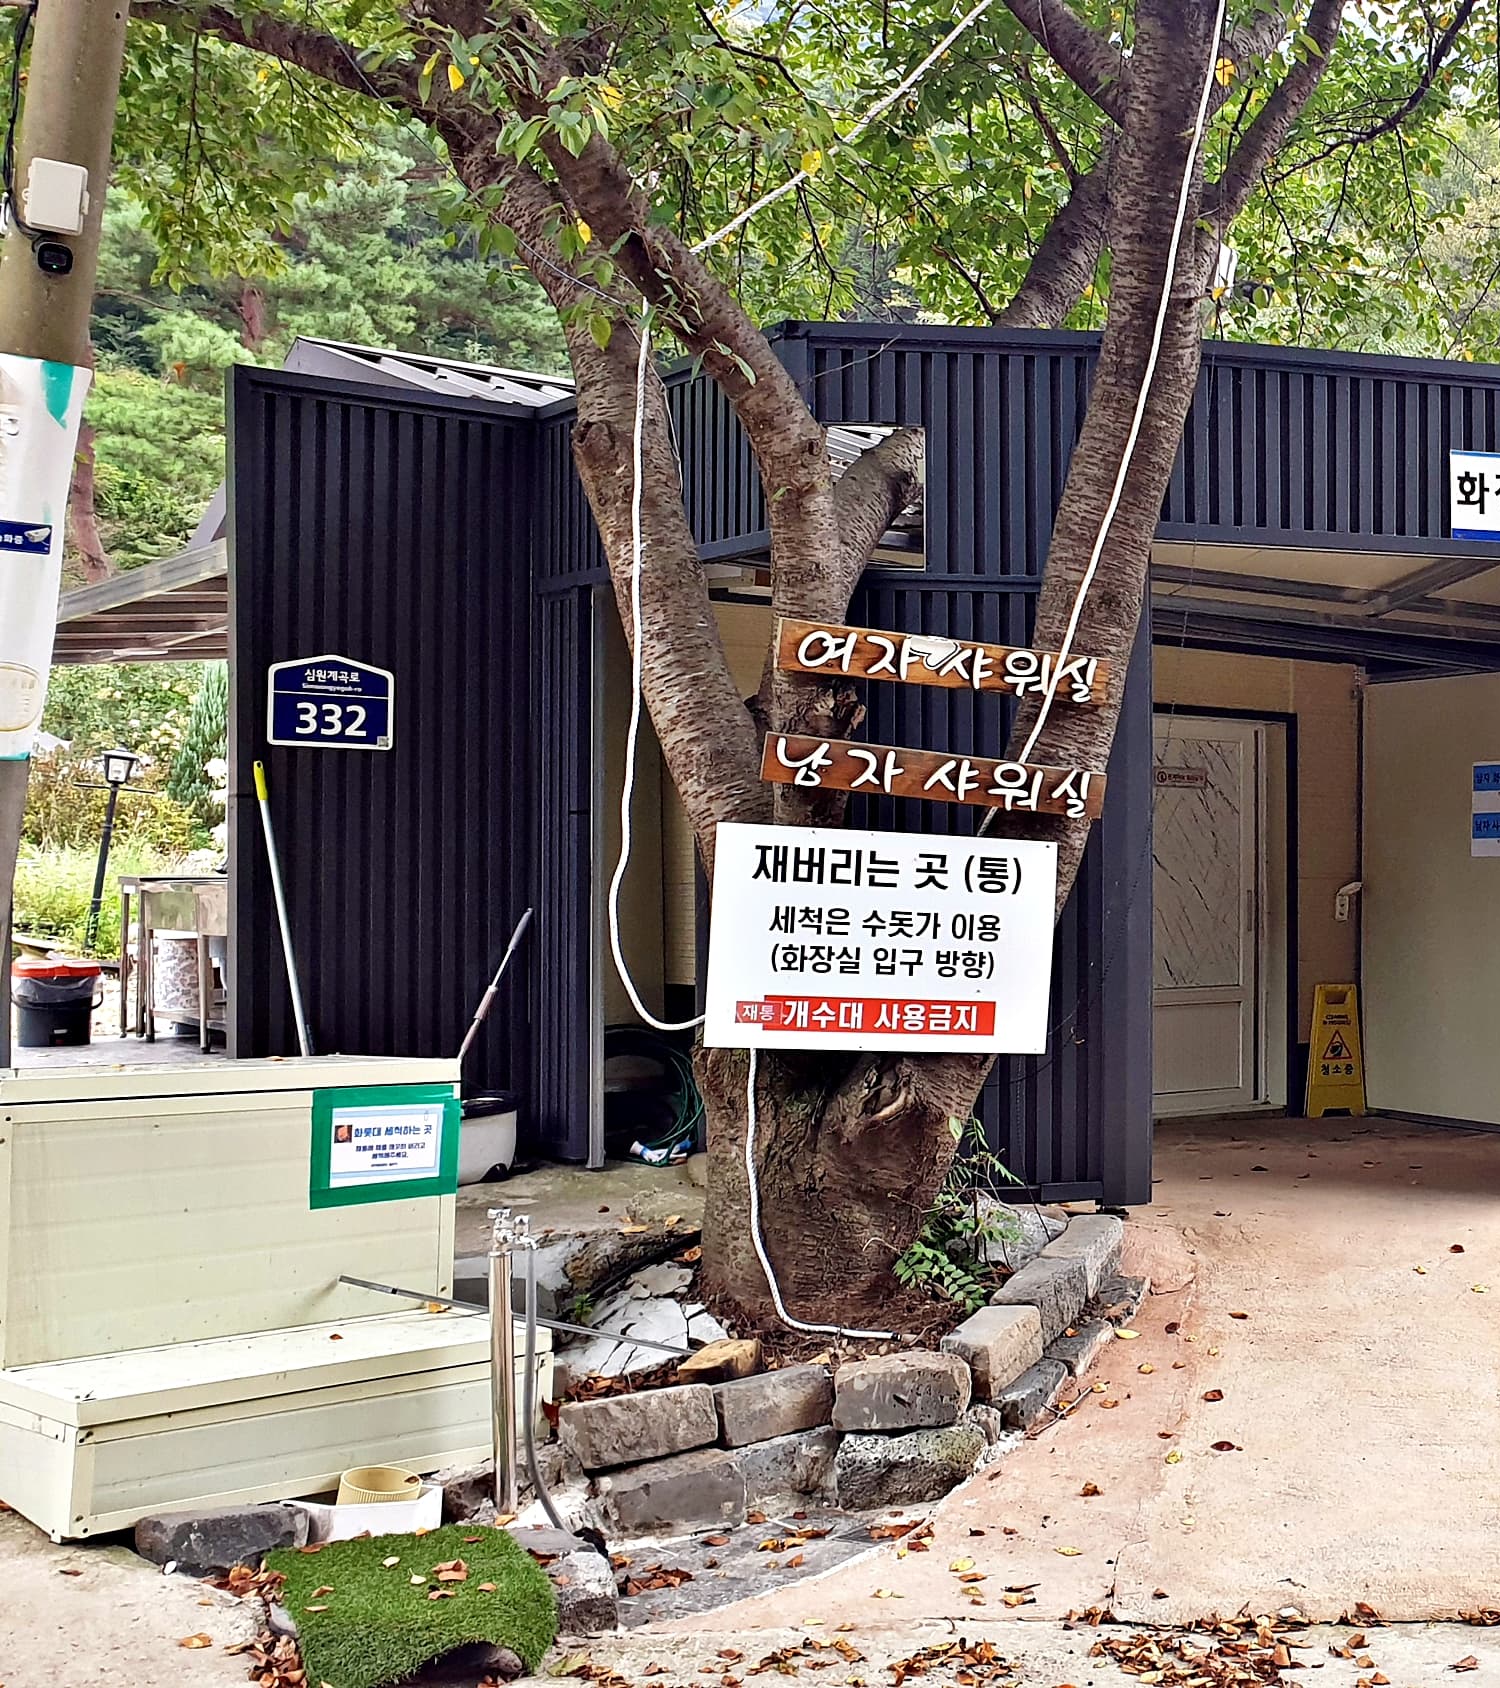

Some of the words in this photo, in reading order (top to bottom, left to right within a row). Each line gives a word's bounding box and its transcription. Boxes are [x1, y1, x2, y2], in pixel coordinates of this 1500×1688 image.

[304, 668, 360, 684] 심원계곡로
[797, 631, 914, 681] 여자
[940, 648, 1097, 703] 샤워실
[295, 702, 367, 736] 332
[776, 737, 905, 794] 남자
[924, 759, 1092, 818] 샤워실
[752, 844, 900, 889] 재버리는
[914, 853, 950, 891] 곳
[964, 855, 1022, 894] (통)
[769, 905, 850, 936] 세척은
[862, 910, 941, 940] 수돗가
[951, 913, 1001, 942] 이용
[770, 943, 861, 975] (화장실
[874, 948, 924, 977] 입구
[936, 951, 995, 979] 방향)
[742, 1004, 776, 1021] 재통
[783, 1000, 864, 1030] 개수대
[874, 1002, 978, 1032] 사용금지
[384, 1125, 421, 1137] 세척하는
[424, 1124, 433, 1134] 곳
